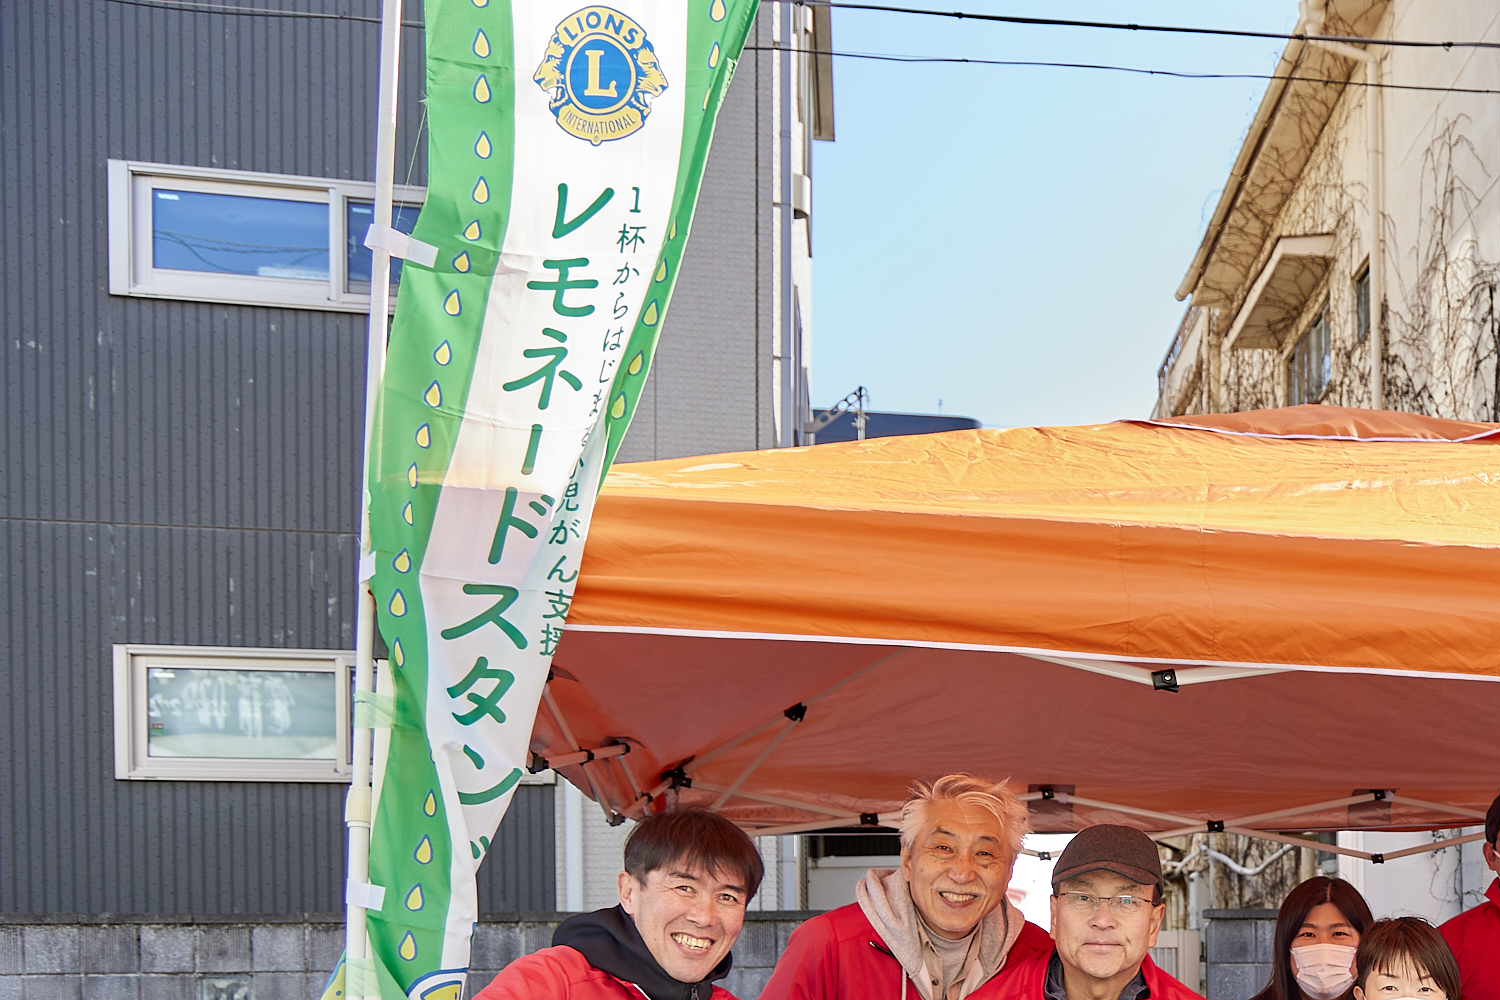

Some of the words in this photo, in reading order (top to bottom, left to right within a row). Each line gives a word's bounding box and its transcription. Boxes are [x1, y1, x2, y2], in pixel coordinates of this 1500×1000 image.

[563, 11, 639, 45] LIONS
[584, 50, 618, 98] L
[563, 110, 637, 135] INTERNATIONAL
